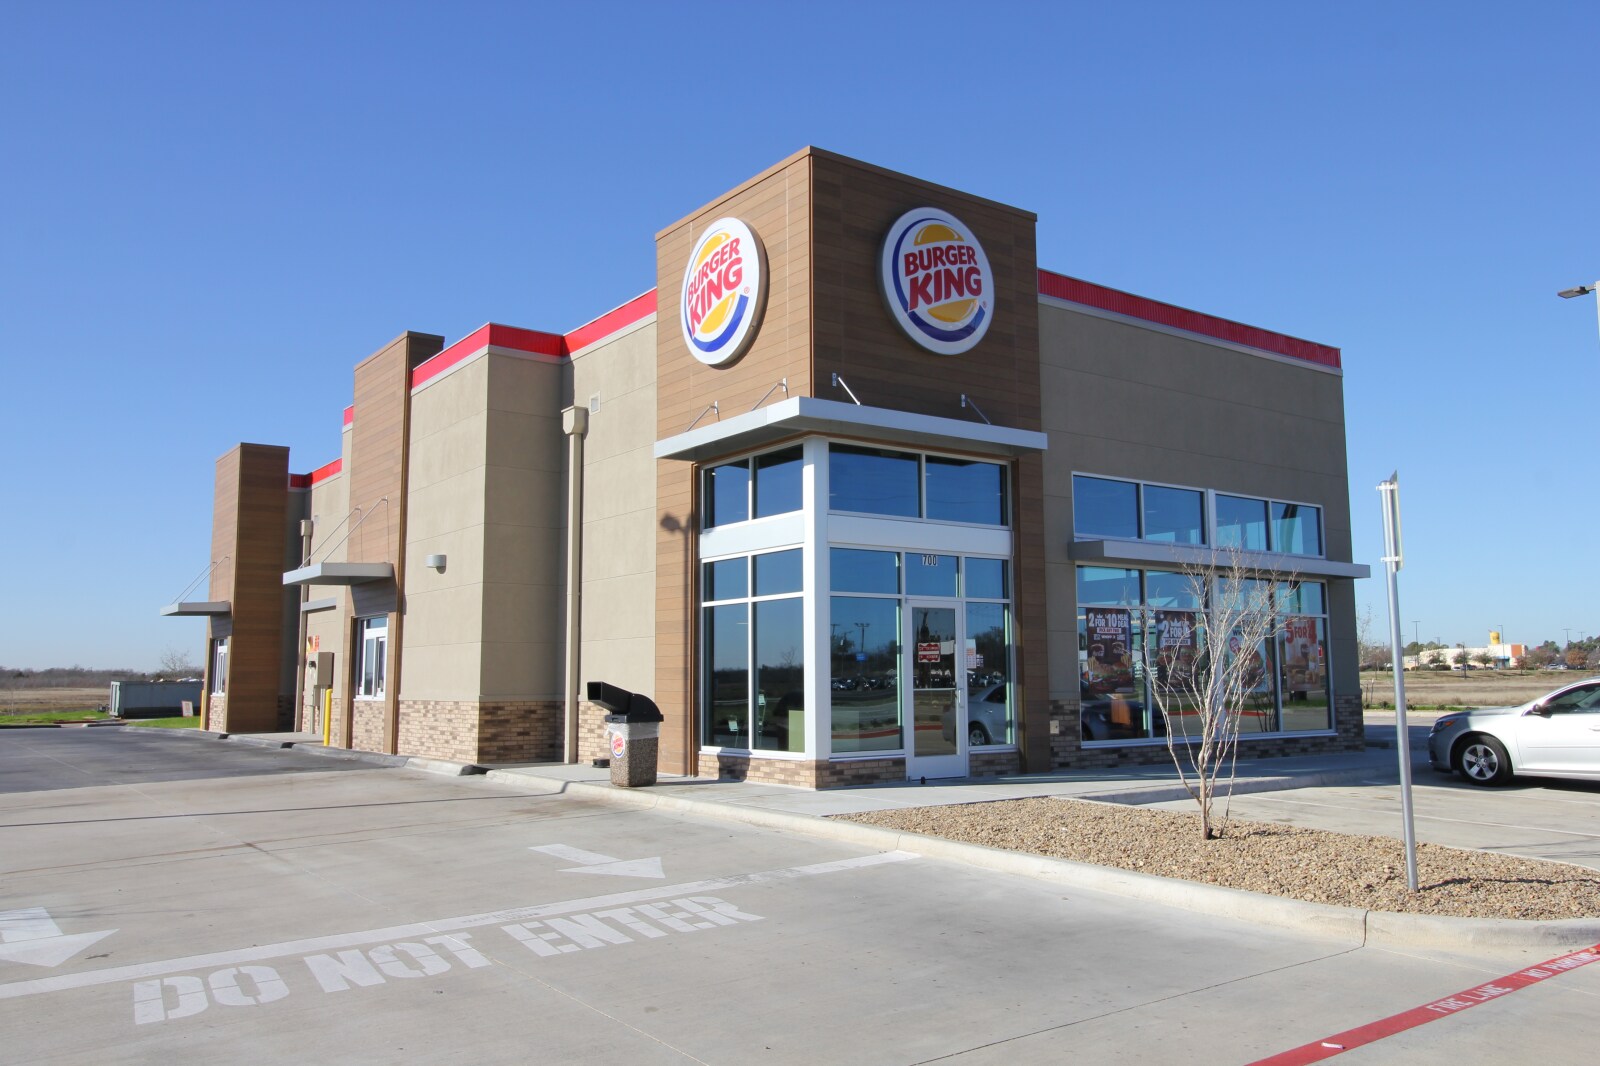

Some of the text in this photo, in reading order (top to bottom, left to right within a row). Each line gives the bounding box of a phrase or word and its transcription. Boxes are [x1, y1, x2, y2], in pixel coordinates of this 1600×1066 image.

[688, 237, 740, 300] BURGER
[904, 244, 978, 277] BURGER
[689, 257, 742, 337] KING
[908, 266, 982, 310] KING
[922, 555, 937, 566] 700
[1088, 612, 1095, 627] 2
[1095, 618, 1106, 627] FOR
[1117, 620, 1129, 628] DEAL
[1162, 620, 1169, 638] 2
[1169, 627, 1182, 638] FOR
[1285, 618, 1294, 644] 5
[1294, 626, 1307, 639] FOR
[133, 896, 766, 1025] DO NOT ENTER
[1425, 997, 1474, 1013] FIRE
[1460, 984, 1513, 1001] LANE
[1519, 968, 1553, 979] NO
